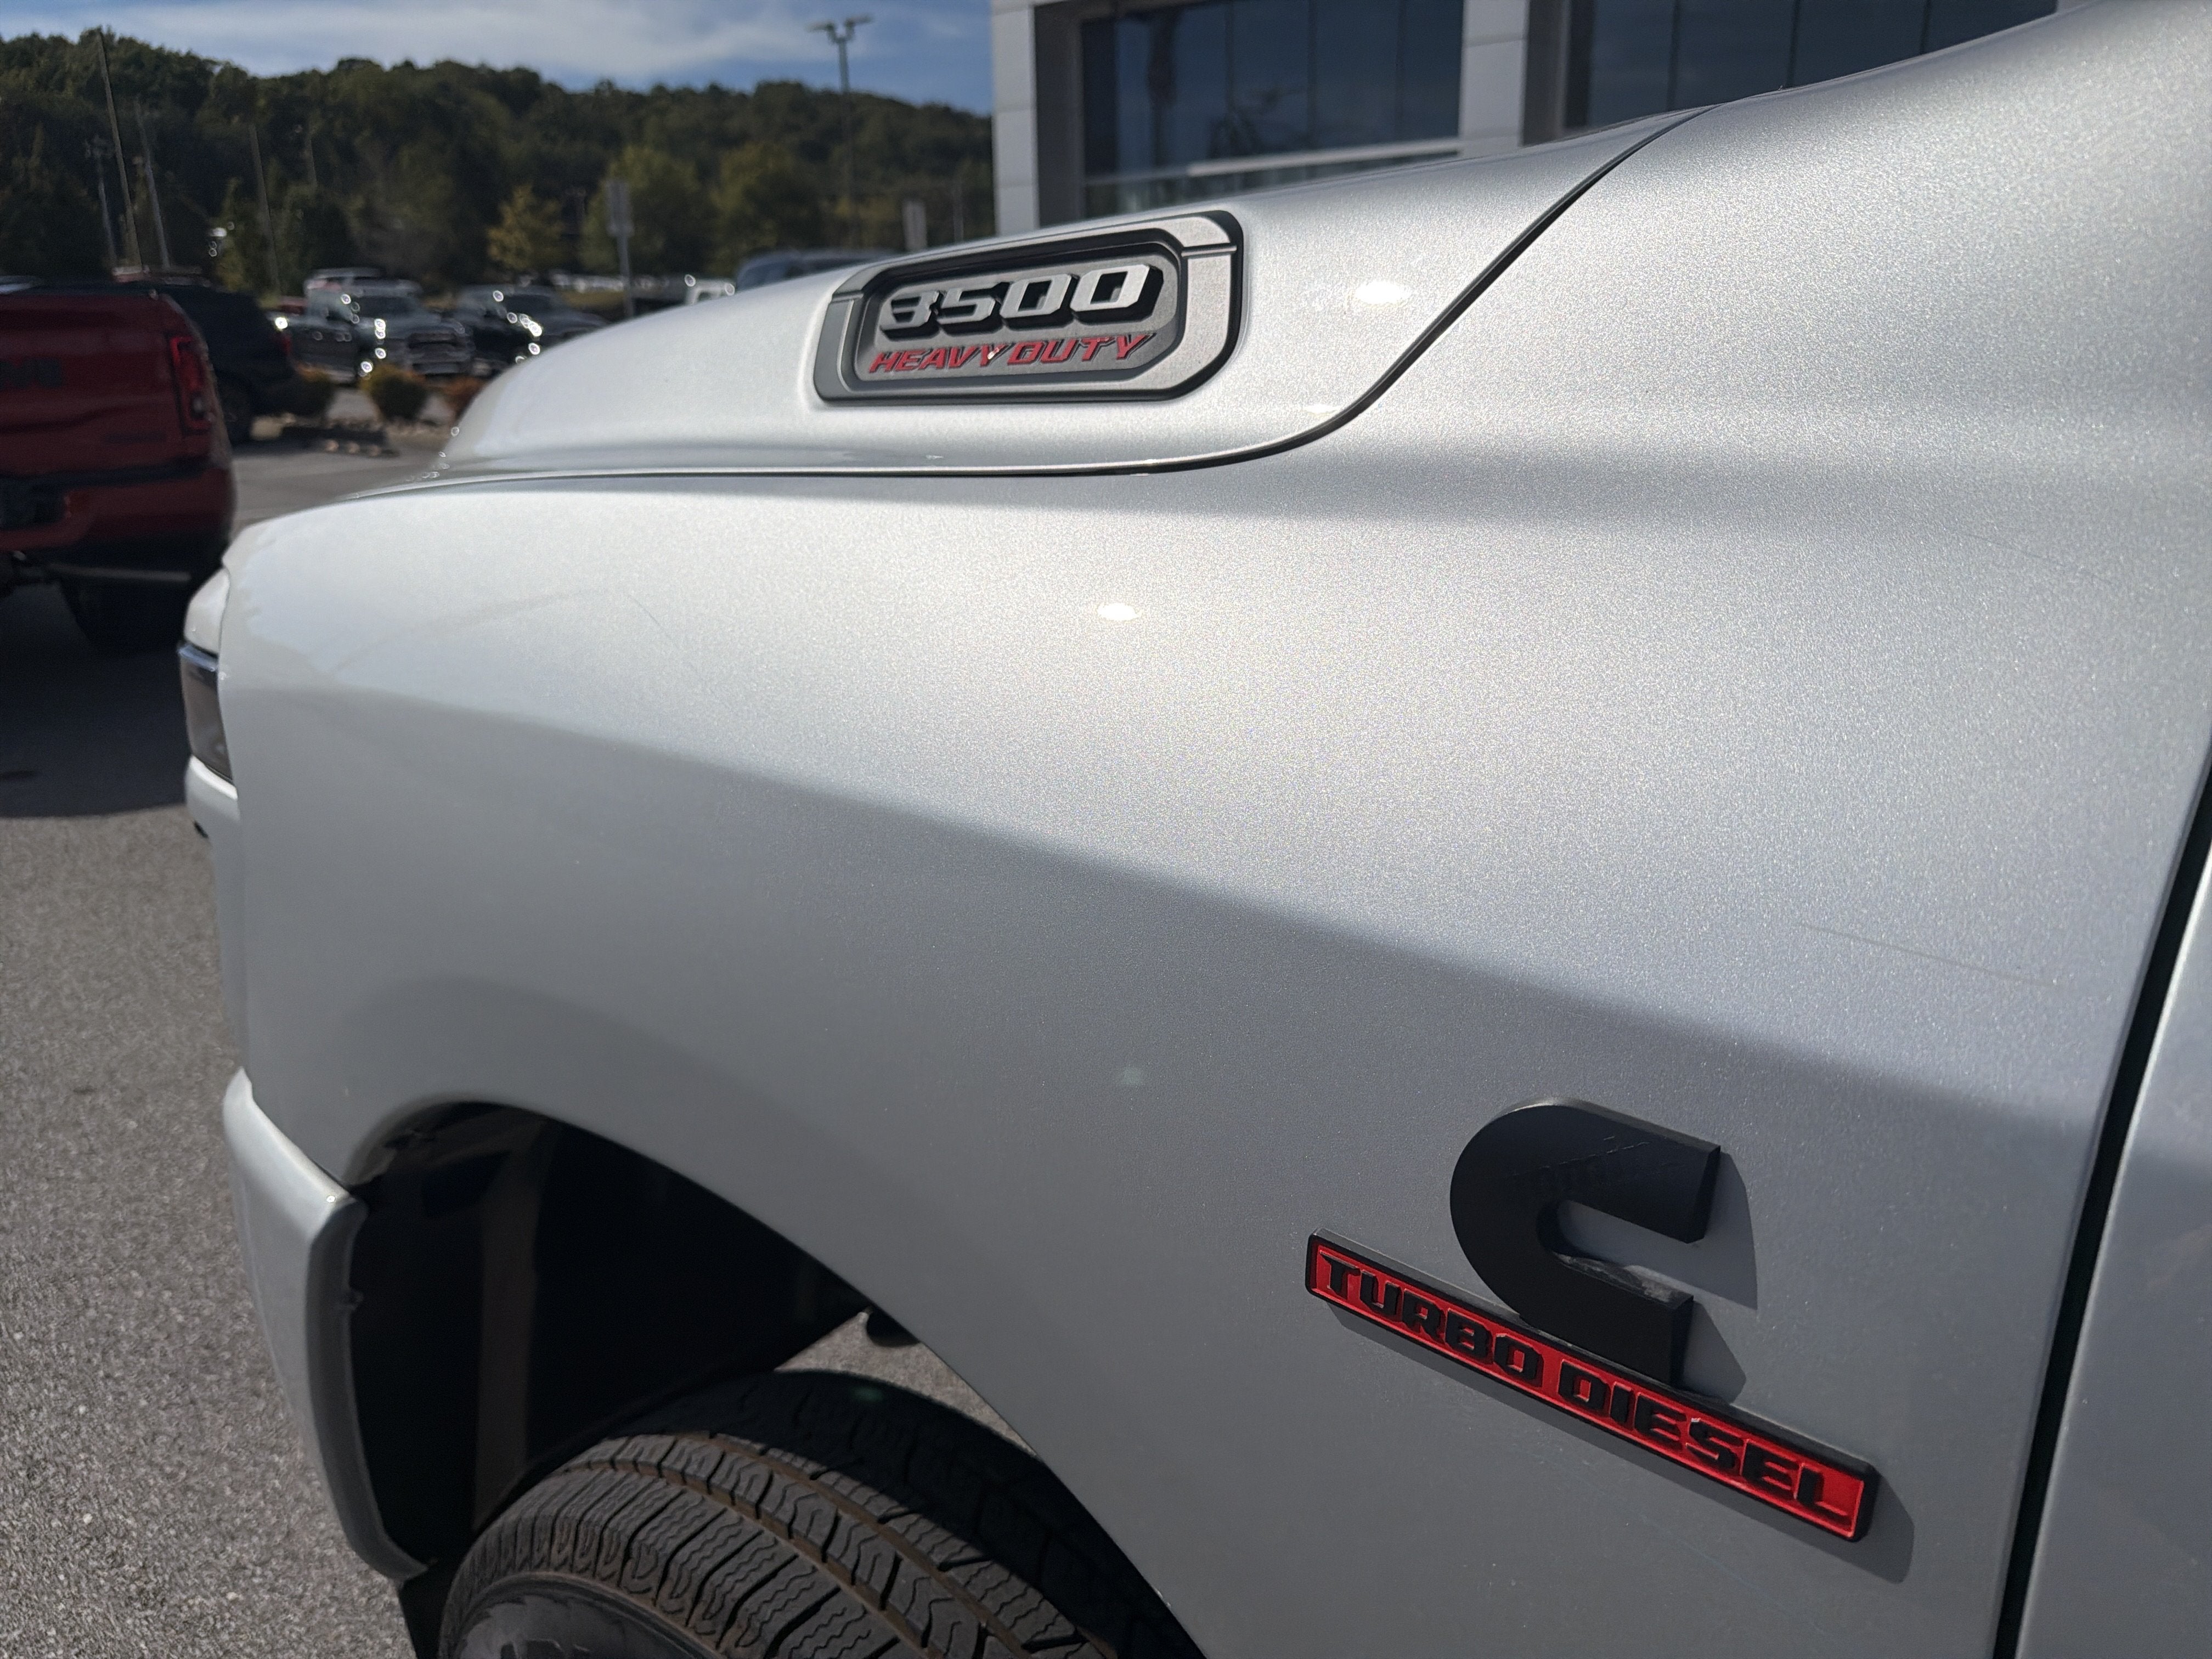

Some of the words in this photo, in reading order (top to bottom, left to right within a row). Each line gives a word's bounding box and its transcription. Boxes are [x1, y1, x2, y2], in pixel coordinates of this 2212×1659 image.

[879, 264, 1162, 340] 3500
[869, 343, 1008, 373] HEAVY
[1007, 333, 1155, 365] DUTY
[1319, 1249, 1543, 1387] TURBO
[1558, 1359, 1850, 1525] DIESEL
